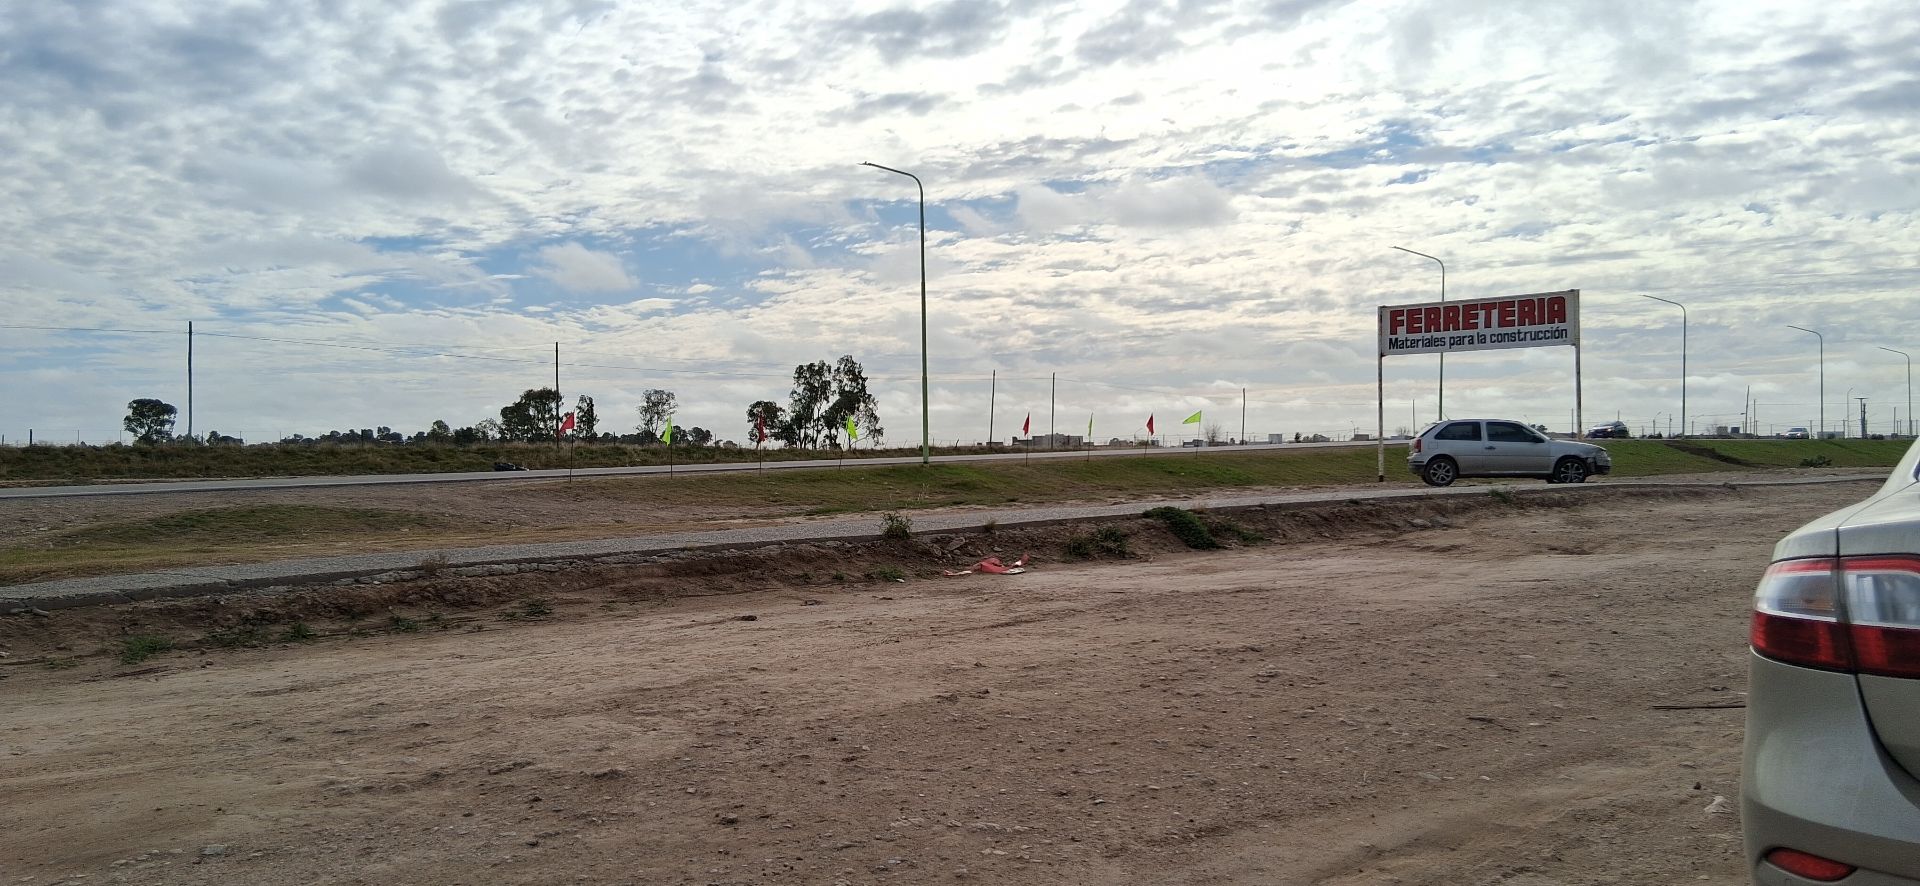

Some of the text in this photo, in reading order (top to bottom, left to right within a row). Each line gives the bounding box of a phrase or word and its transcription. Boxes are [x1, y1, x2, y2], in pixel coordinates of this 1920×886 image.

[1389, 296, 1566, 335] FERRETERIA
[1388, 326, 1567, 350] Materiales para la construcción
